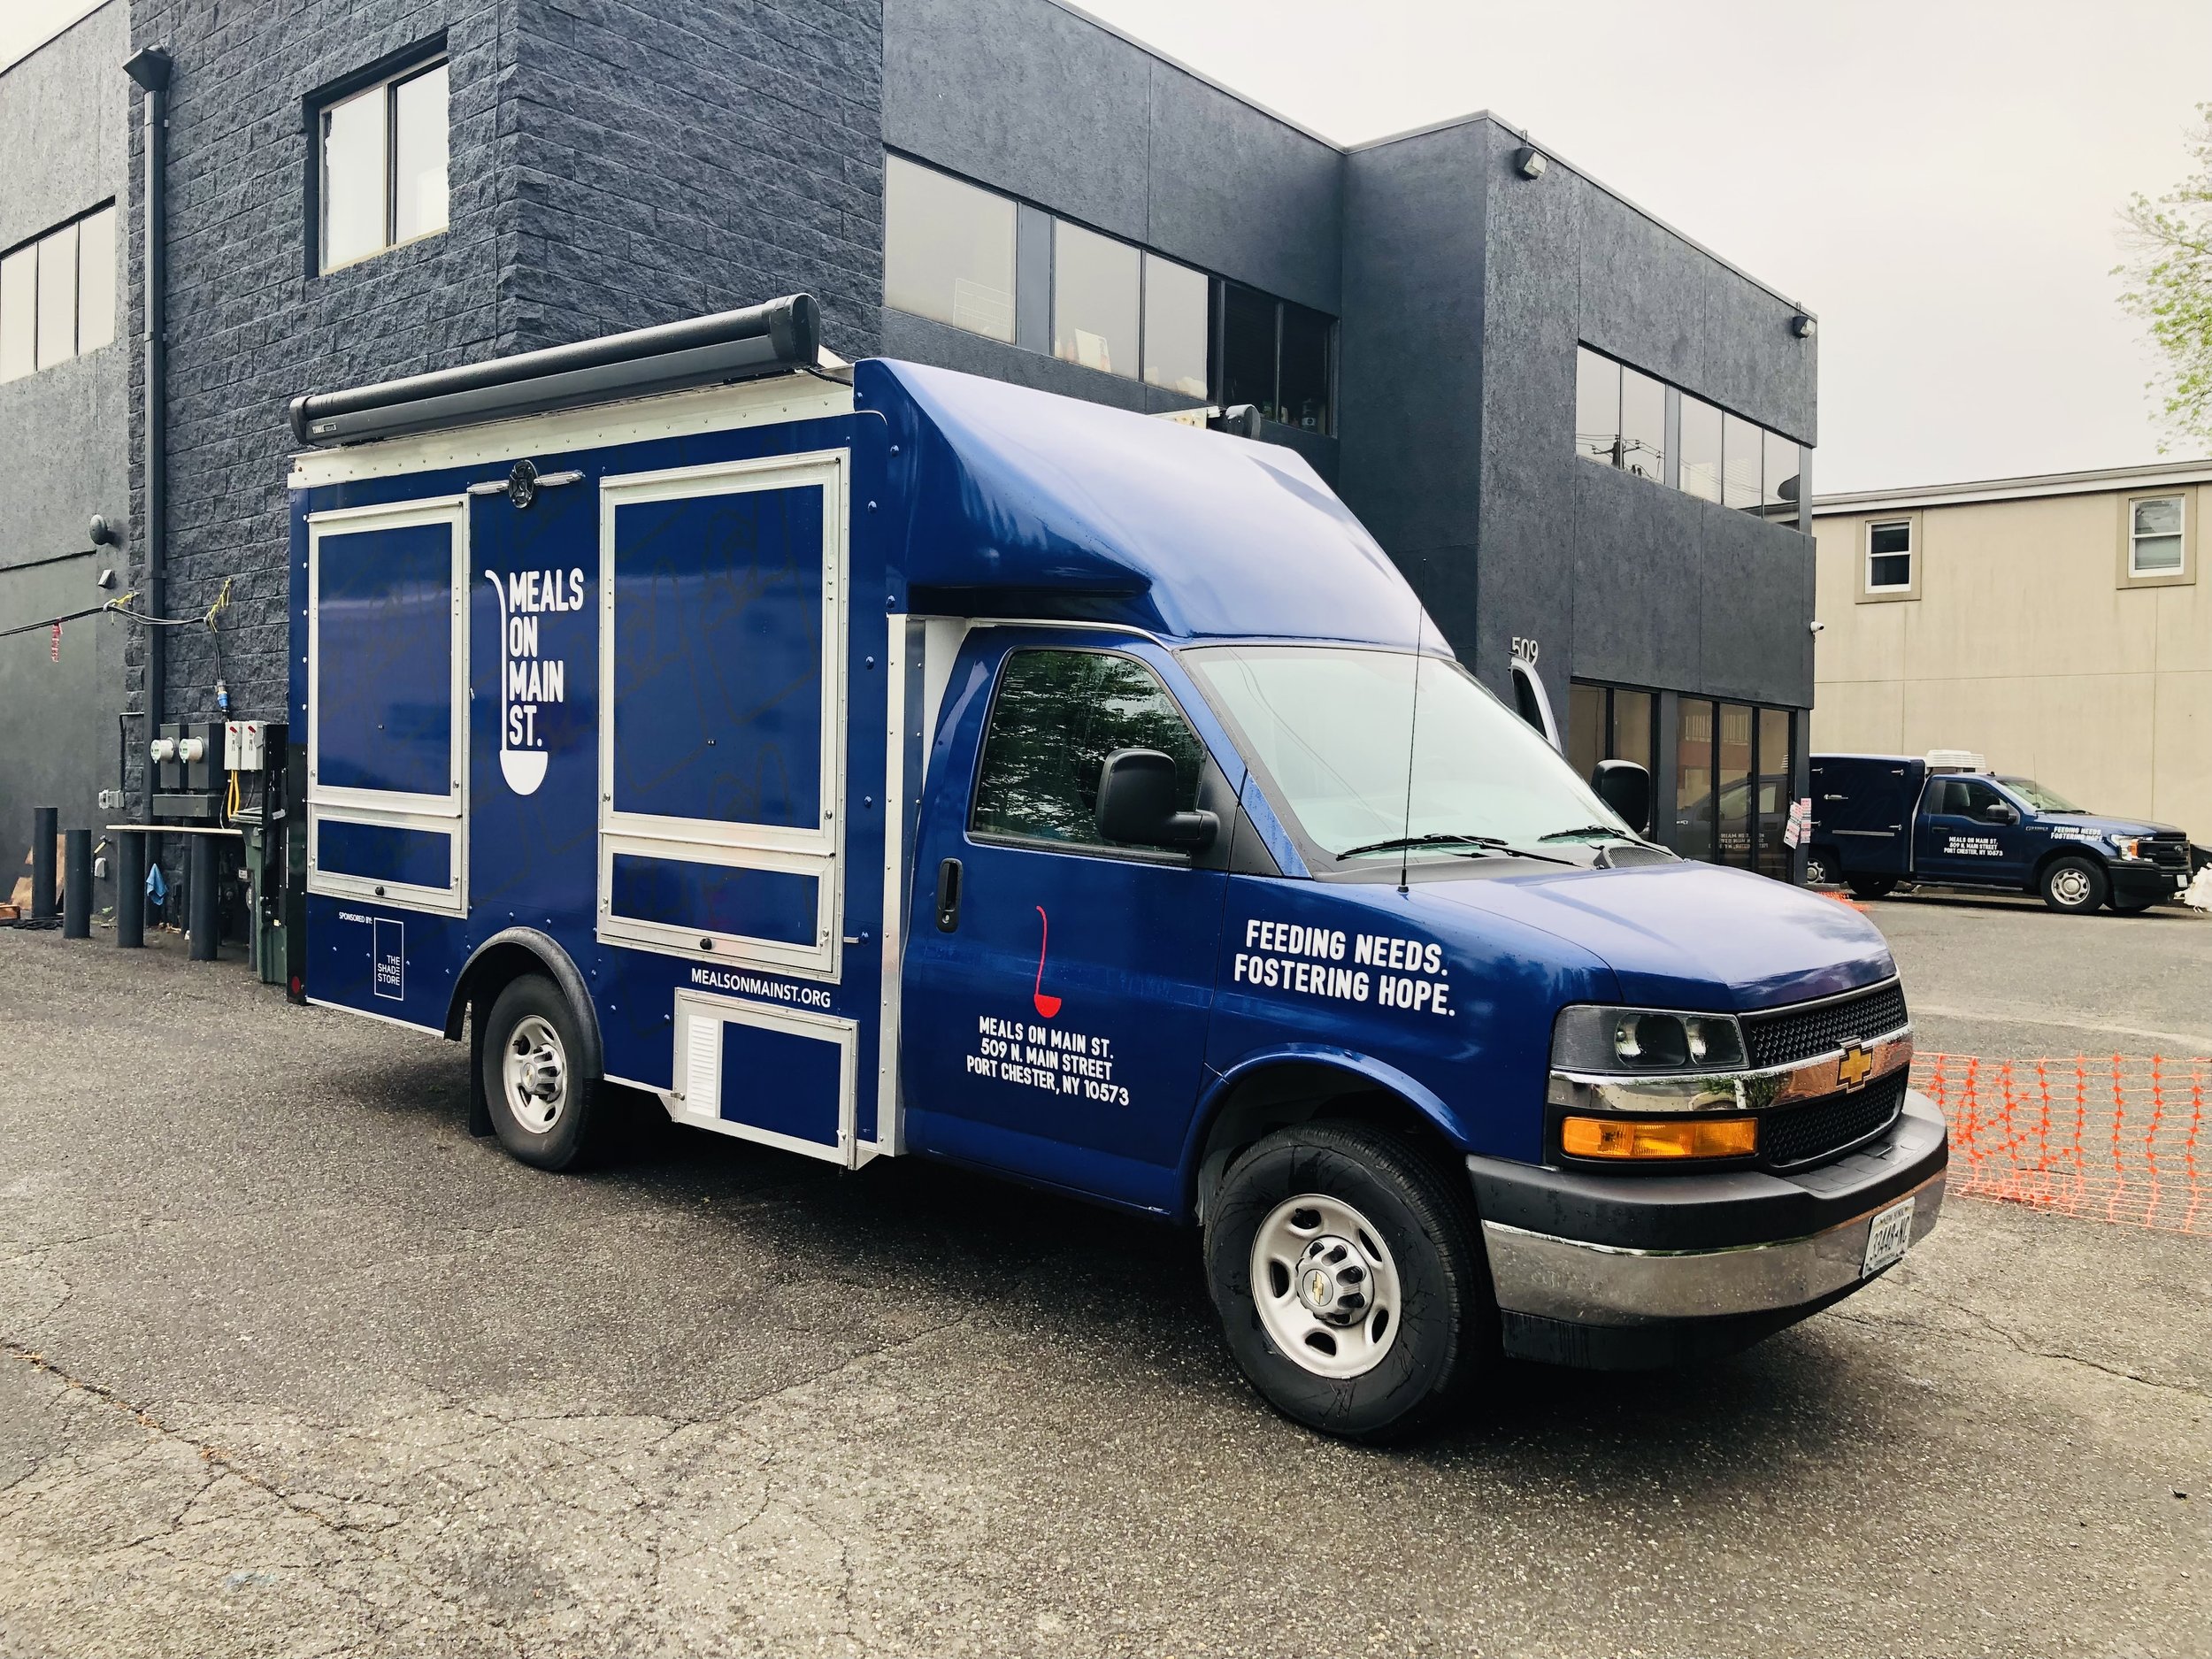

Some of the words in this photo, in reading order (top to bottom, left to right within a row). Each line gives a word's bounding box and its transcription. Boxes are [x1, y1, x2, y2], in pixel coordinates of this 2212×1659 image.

[510, 568, 584, 612] MEALS
[510, 616, 538, 657] ON
[1512, 636, 1539, 667] 509
[510, 660, 564, 703] MAIN
[510, 704, 542, 747] ST.
[338, 911, 365, 924] SPONSORED
[386, 955, 401, 966] THE
[1246, 918, 1346, 961] FEEDING
[1355, 933, 1448, 976] NEEDS.
[377, 963, 401, 976] SHADE
[377, 973, 401, 987] STORE
[691, 967, 831, 1009] MEALSONMAINST.ORG
[1234, 953, 1370, 1002] FOSTERING
[1379, 975, 1455, 1017] HOPE.
[979, 1015, 1024, 1041] MEALS
[1028, 1025, 1047, 1046] ON
[1050, 1029, 1087, 1054] MAIN
[1091, 1037, 1114, 1059] ST.
[966, 1055, 998, 1078] PORT
[1001, 1062, 1060, 1095] CHESTER,
[1063, 1074, 1080, 1095] NY
[1083, 1079, 1130, 1106] 10573
[980, 1037, 1008, 1058] 509
[1010, 1043, 1024, 1063] N.
[1025, 1046, 1059, 1071] MAIN
[1062, 1054, 1113, 1081] STREET
